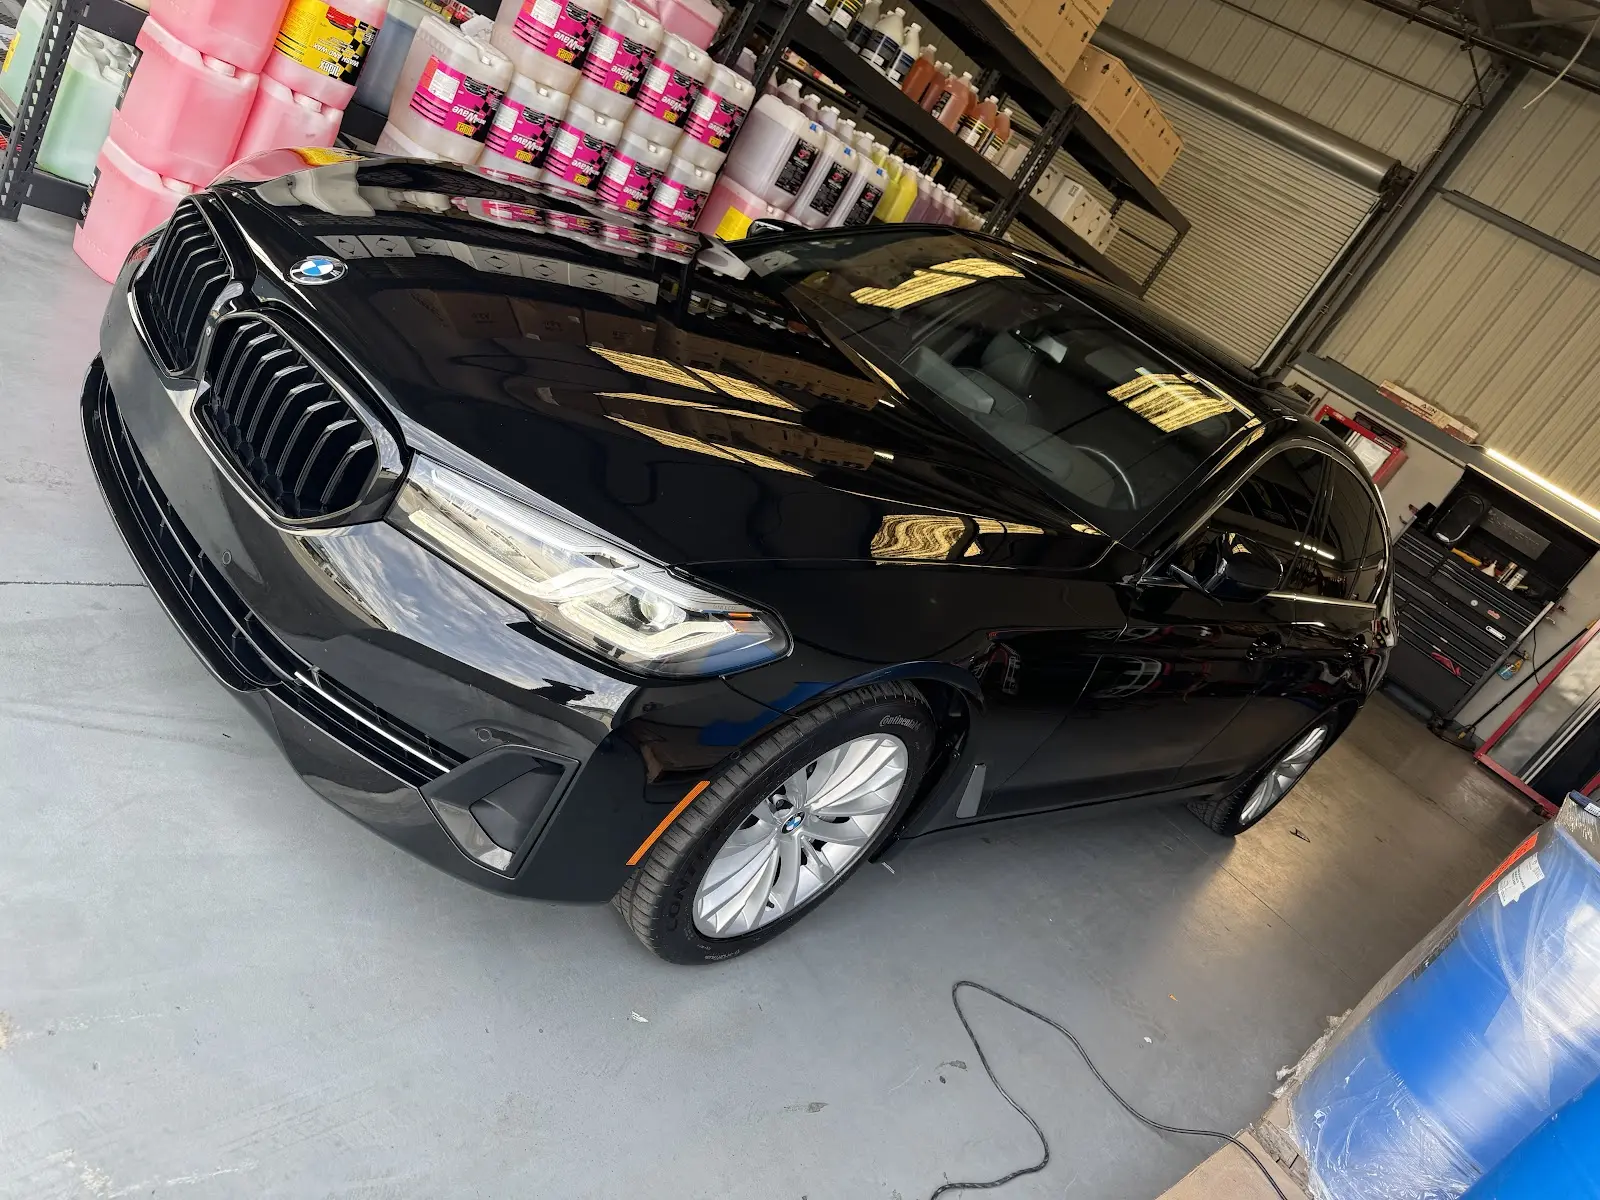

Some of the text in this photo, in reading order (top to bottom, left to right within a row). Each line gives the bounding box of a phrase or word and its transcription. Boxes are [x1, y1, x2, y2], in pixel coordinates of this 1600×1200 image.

[553, 31, 579, 50] Wave
[313, 43, 360, 68] WASH AND WAX
[611, 65, 634, 82] Wave
[661, 96, 682, 112] Wave
[452, 105, 478, 124] Wave
[511, 134, 537, 151] Wave
[571, 160, 593, 175] Wave
[623, 186, 643, 201] Wave
[879, 714, 919, 731] Continental
